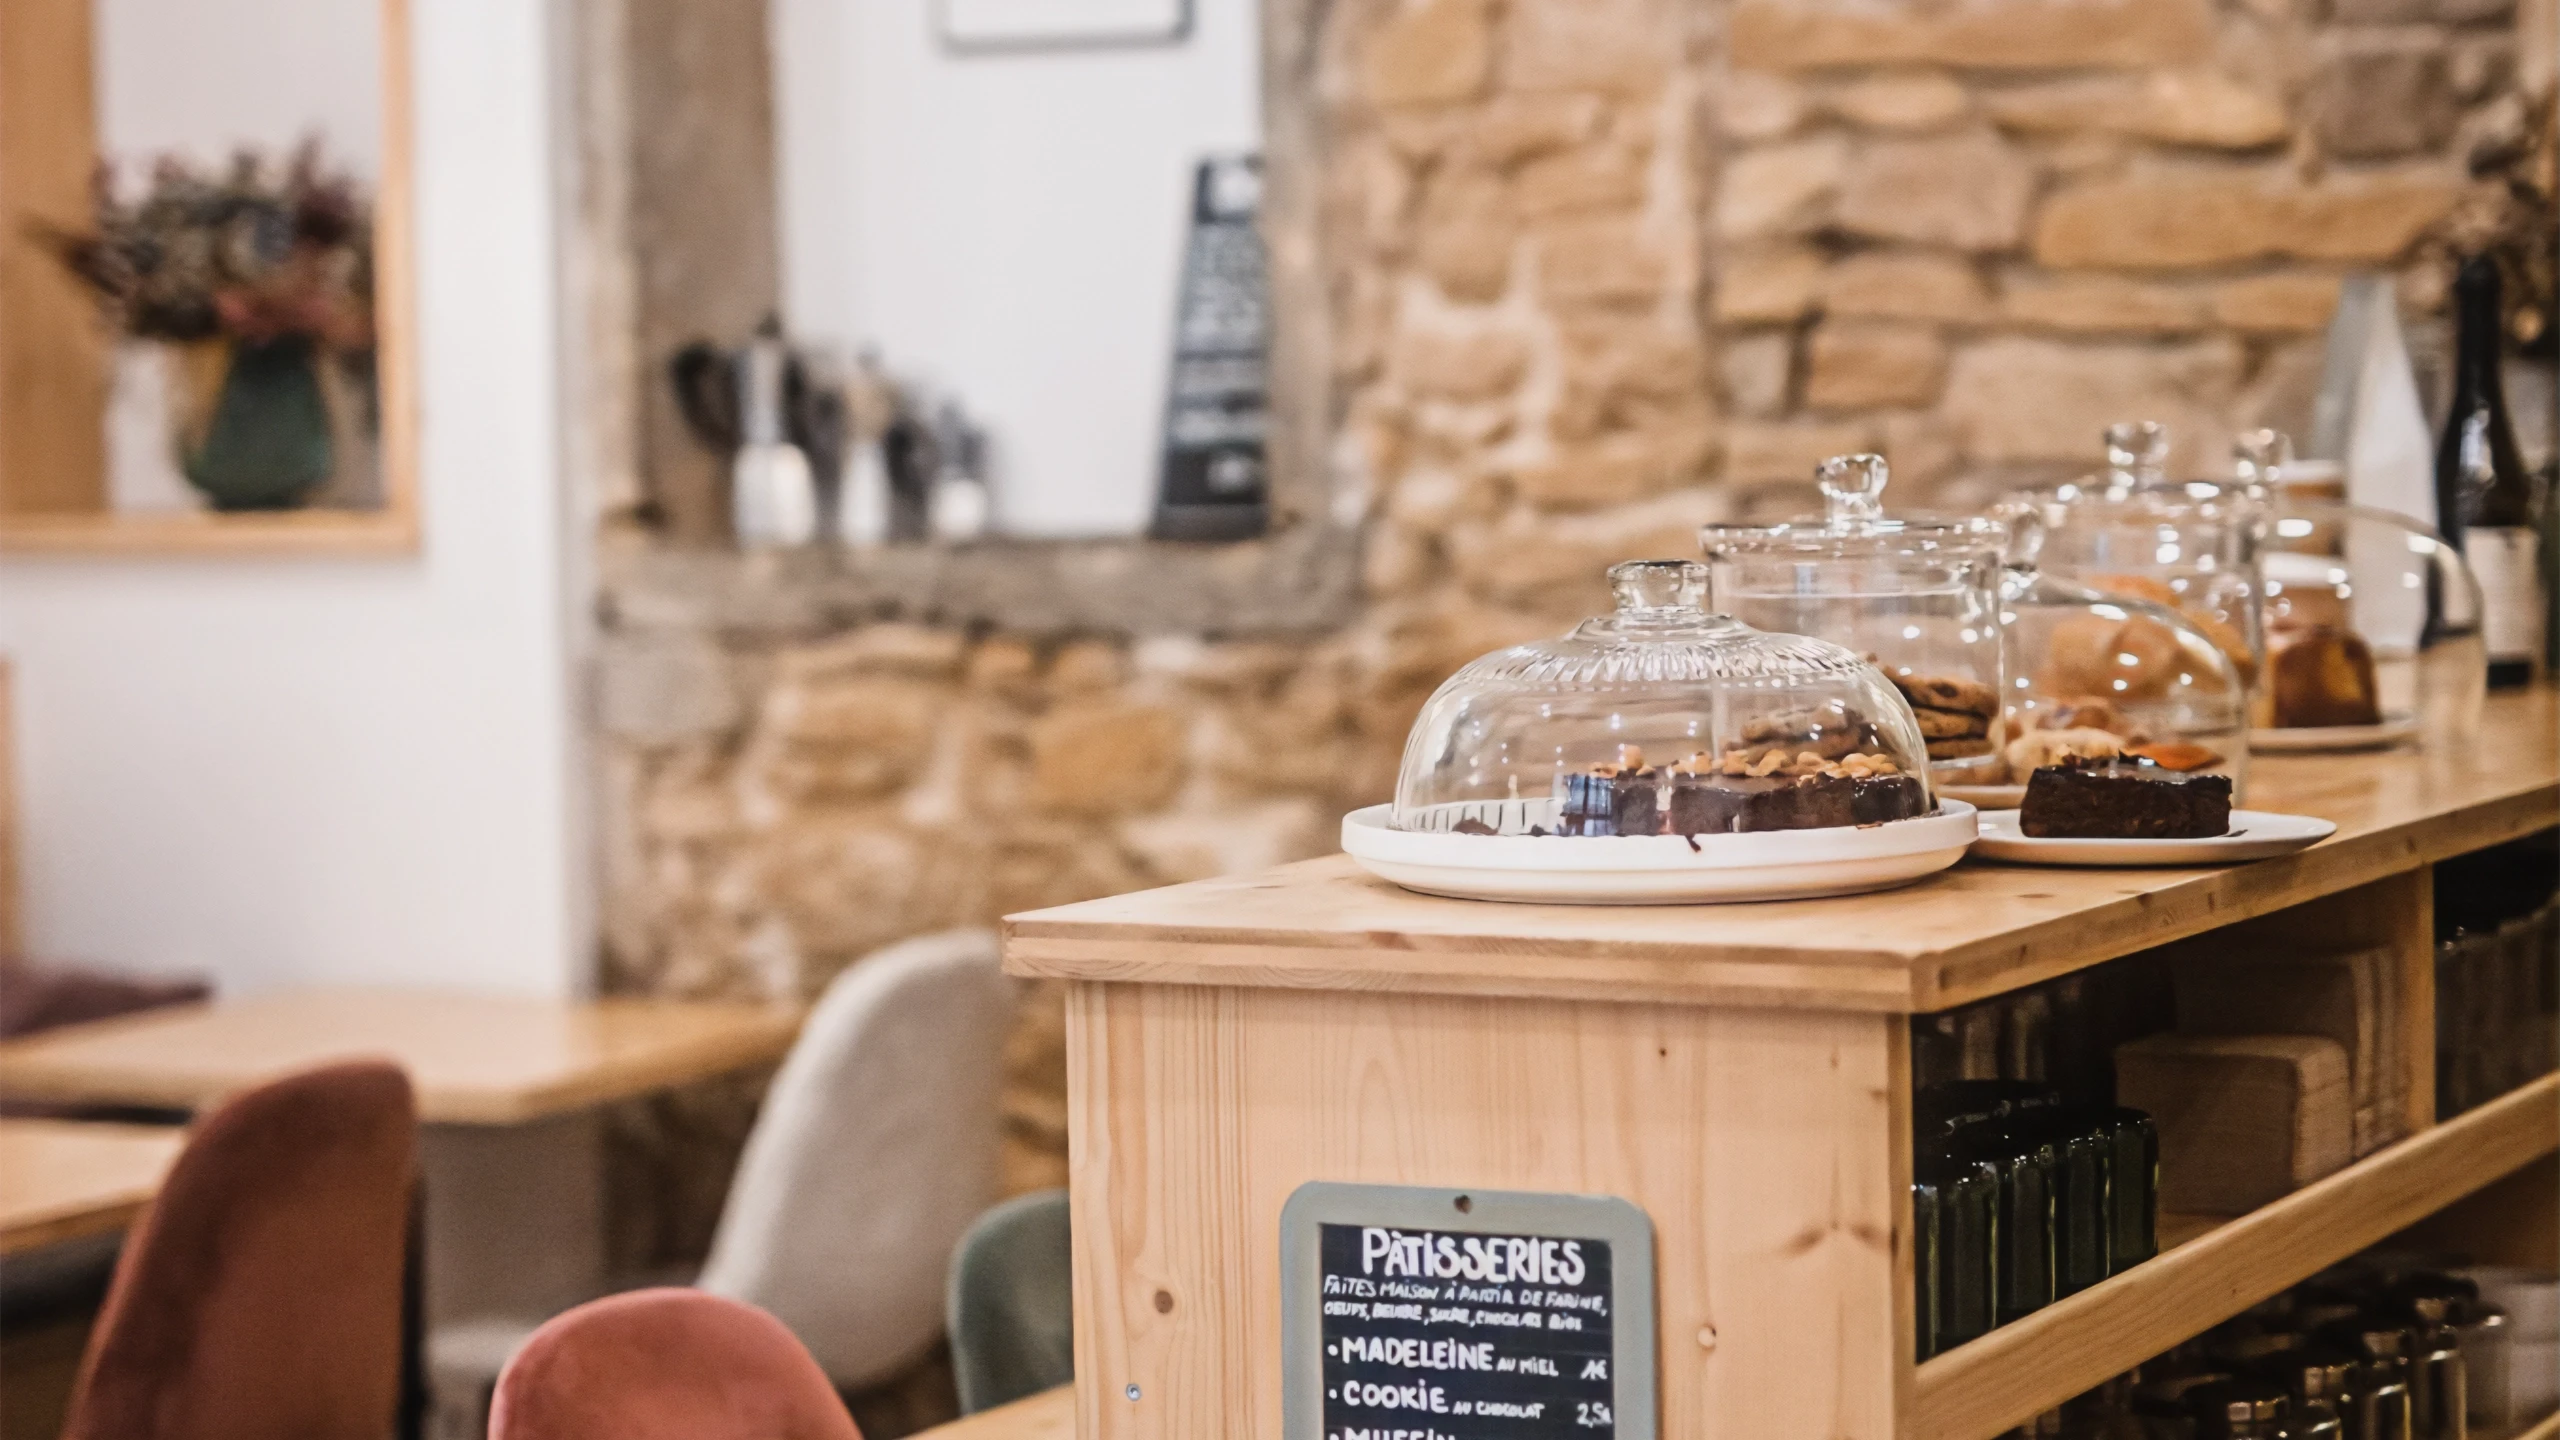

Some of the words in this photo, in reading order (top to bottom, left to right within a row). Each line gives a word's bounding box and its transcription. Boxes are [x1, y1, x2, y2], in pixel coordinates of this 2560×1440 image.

[1519, 1288, 1543, 1307] DE
[1496, 1356, 1517, 1372] AU
[1452, 1400, 1473, 1416] AU
[1475, 1400, 1546, 1420] CHOCOLAT
